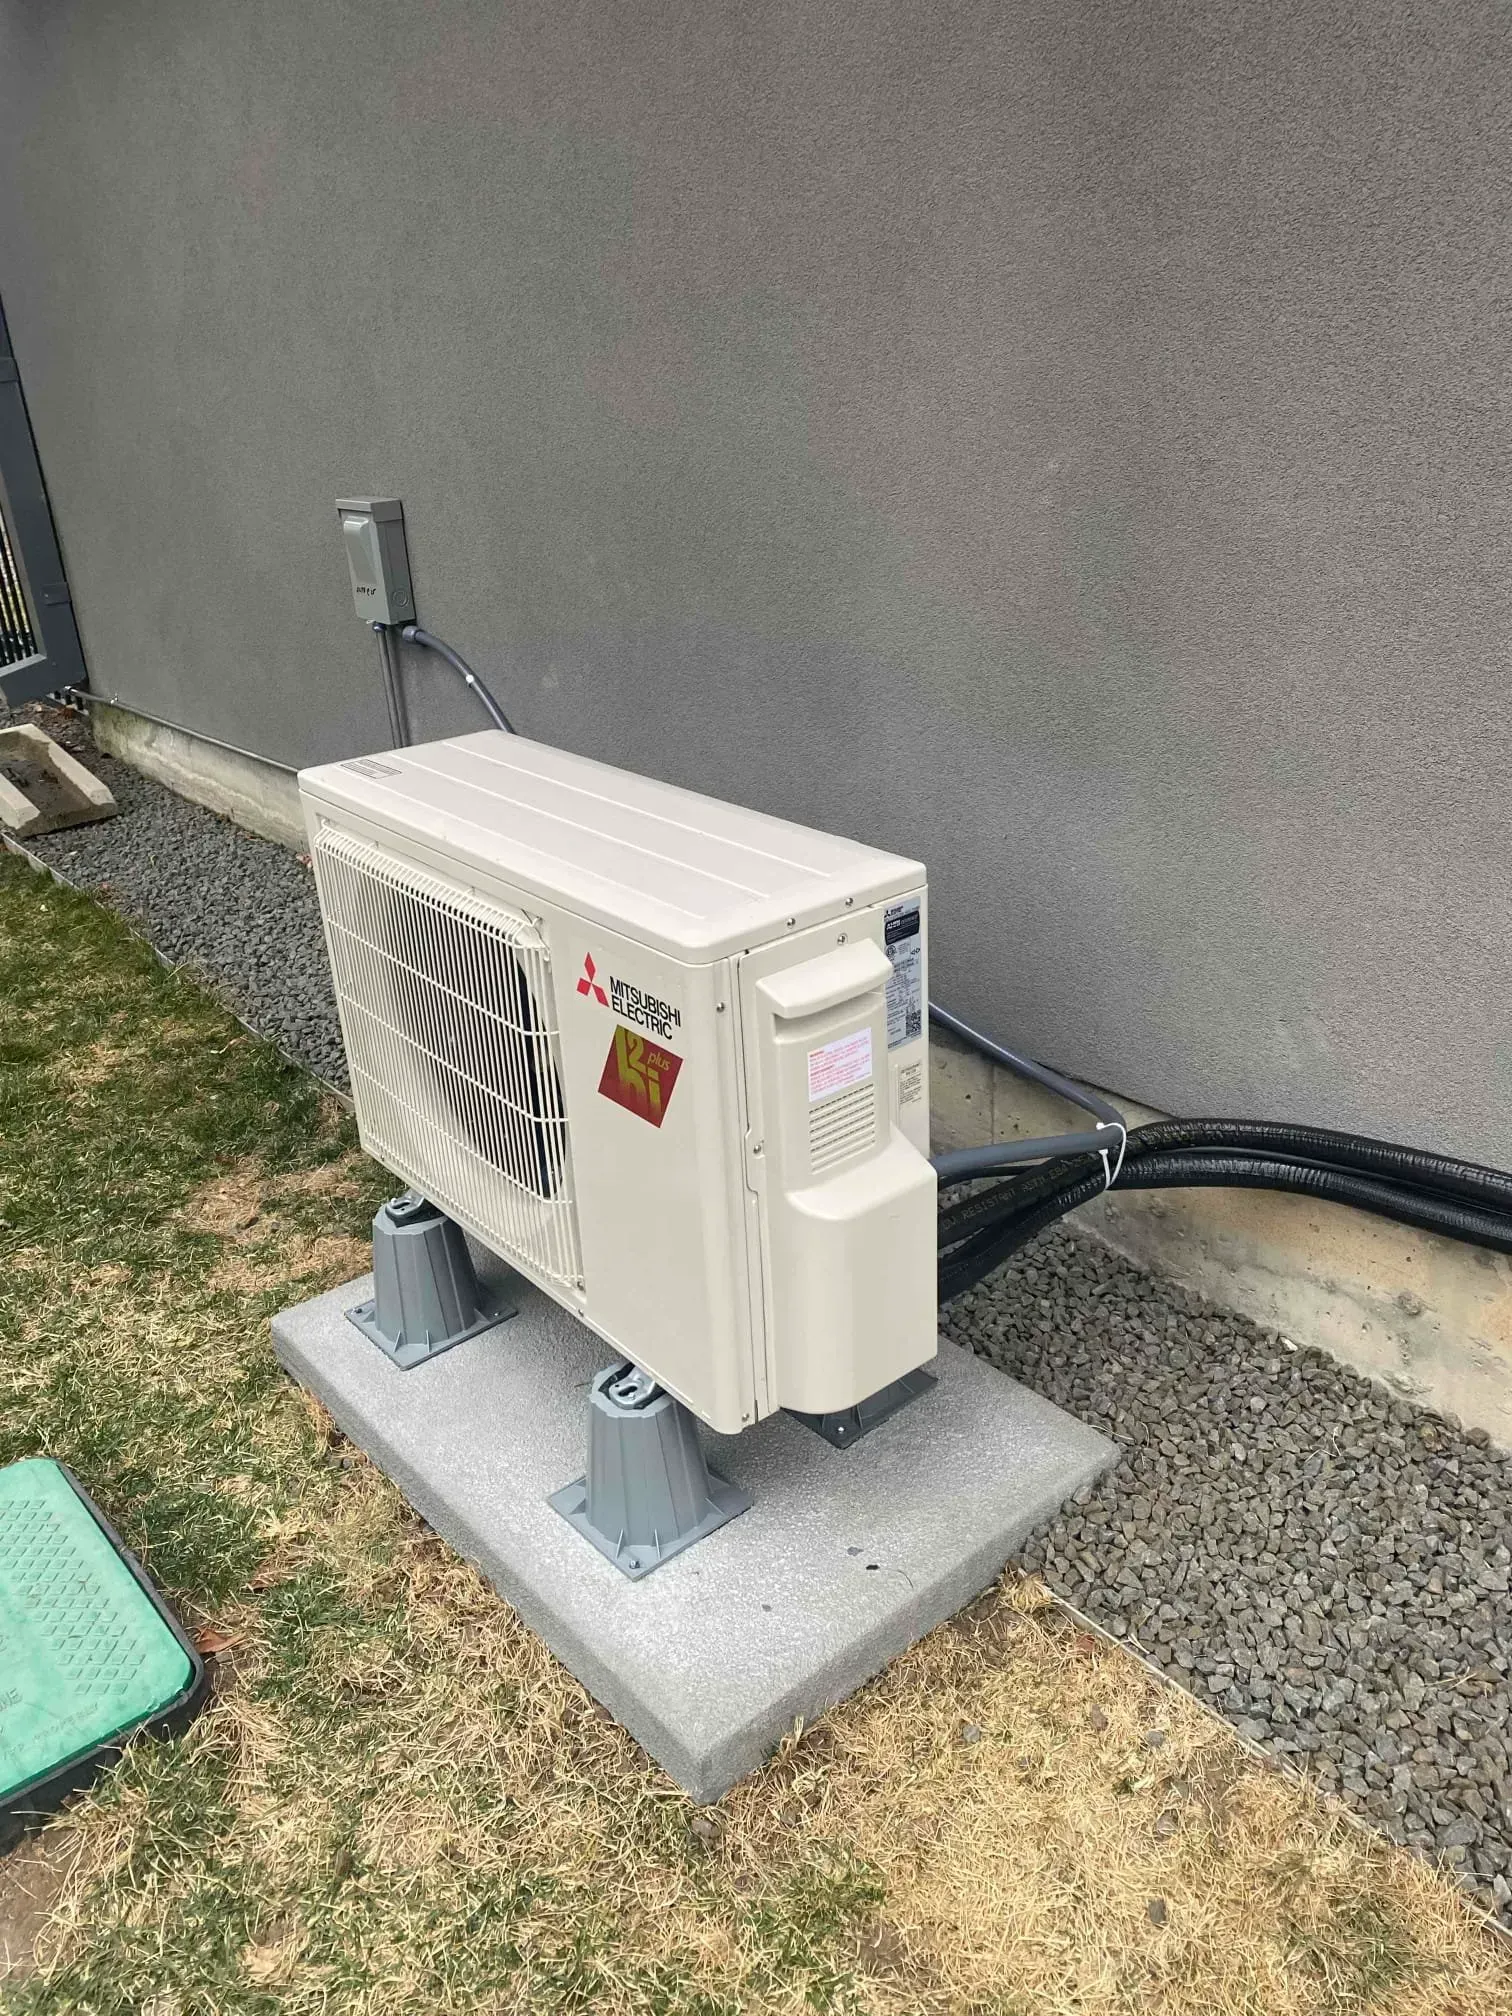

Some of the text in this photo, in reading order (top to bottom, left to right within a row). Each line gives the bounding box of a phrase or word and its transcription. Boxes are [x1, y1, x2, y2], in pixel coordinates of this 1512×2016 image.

[609, 975, 682, 1027] MITSUBISHI
[611, 996, 673, 1040] ELECTRIC
[647, 1051, 670, 1072] plus
